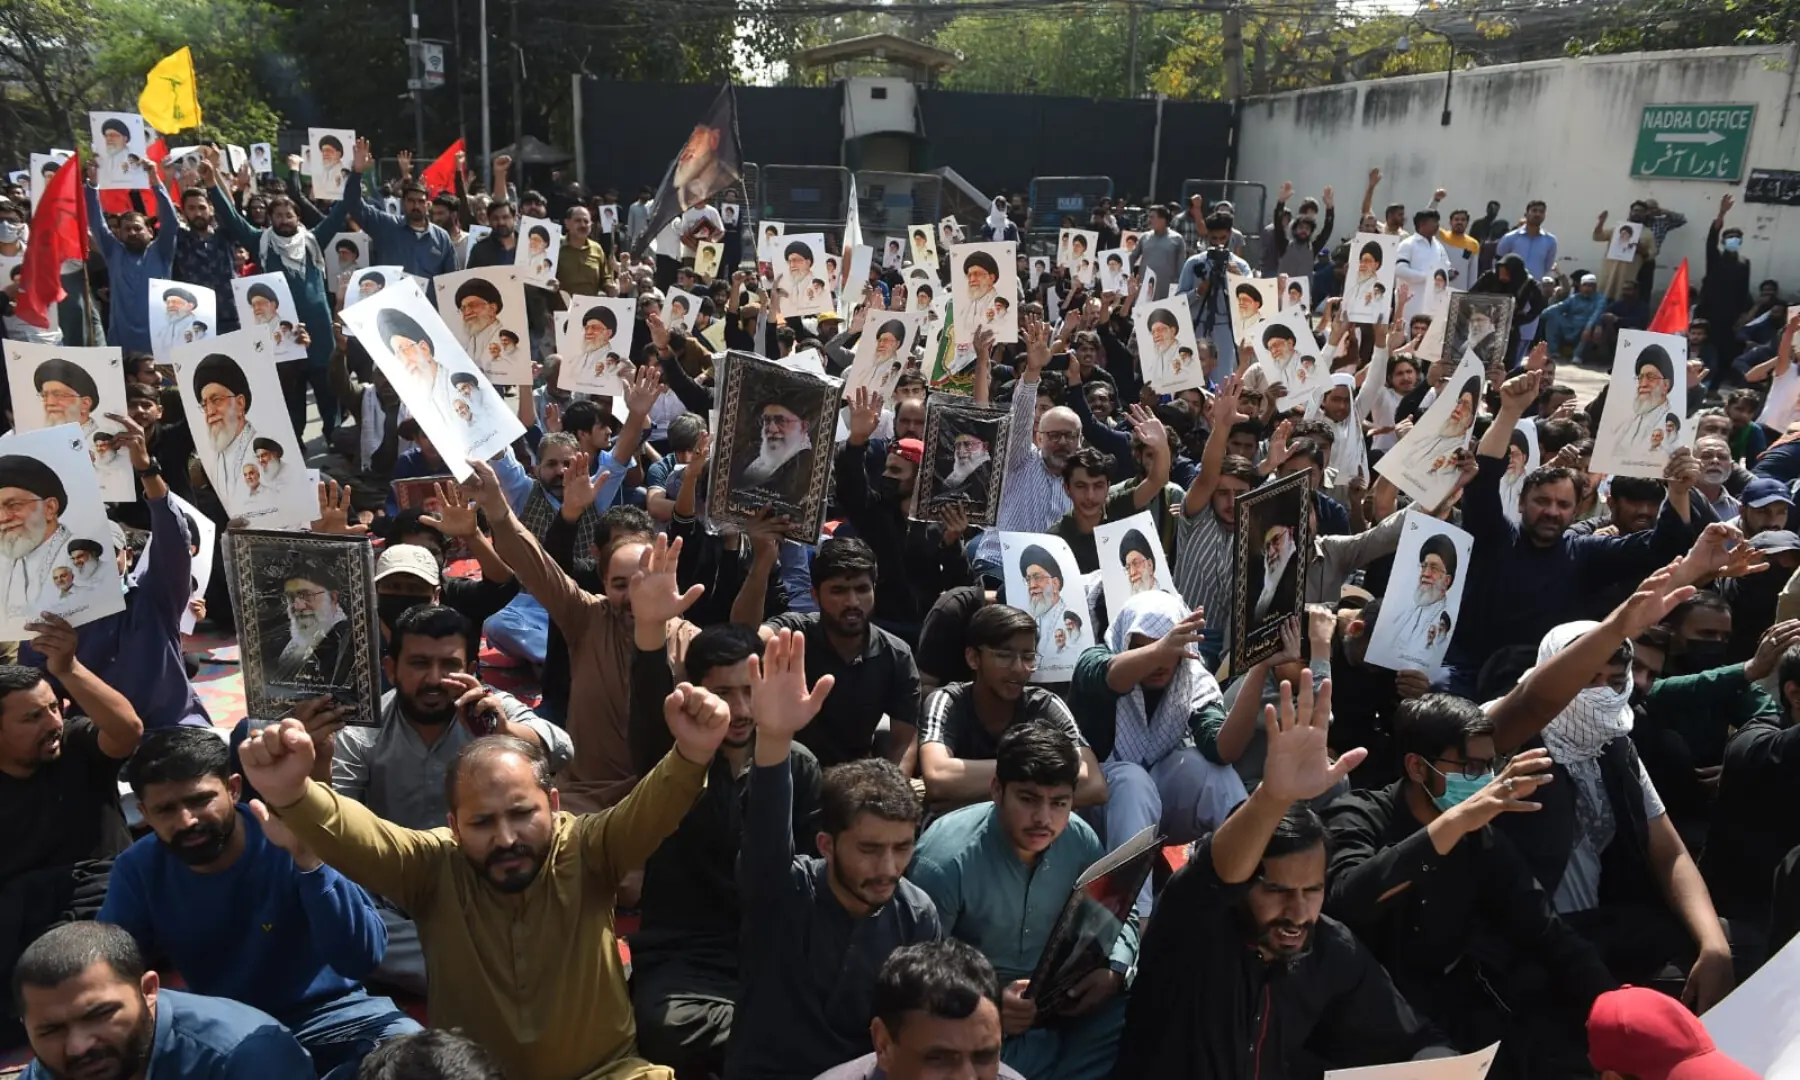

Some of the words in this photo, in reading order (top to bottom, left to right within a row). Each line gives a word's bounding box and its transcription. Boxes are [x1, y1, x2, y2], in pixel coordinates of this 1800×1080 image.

[1643, 110, 1692, 128] NADRA
[1696, 110, 1749, 128] OFFICE
[1641, 143, 1689, 175] آفس
